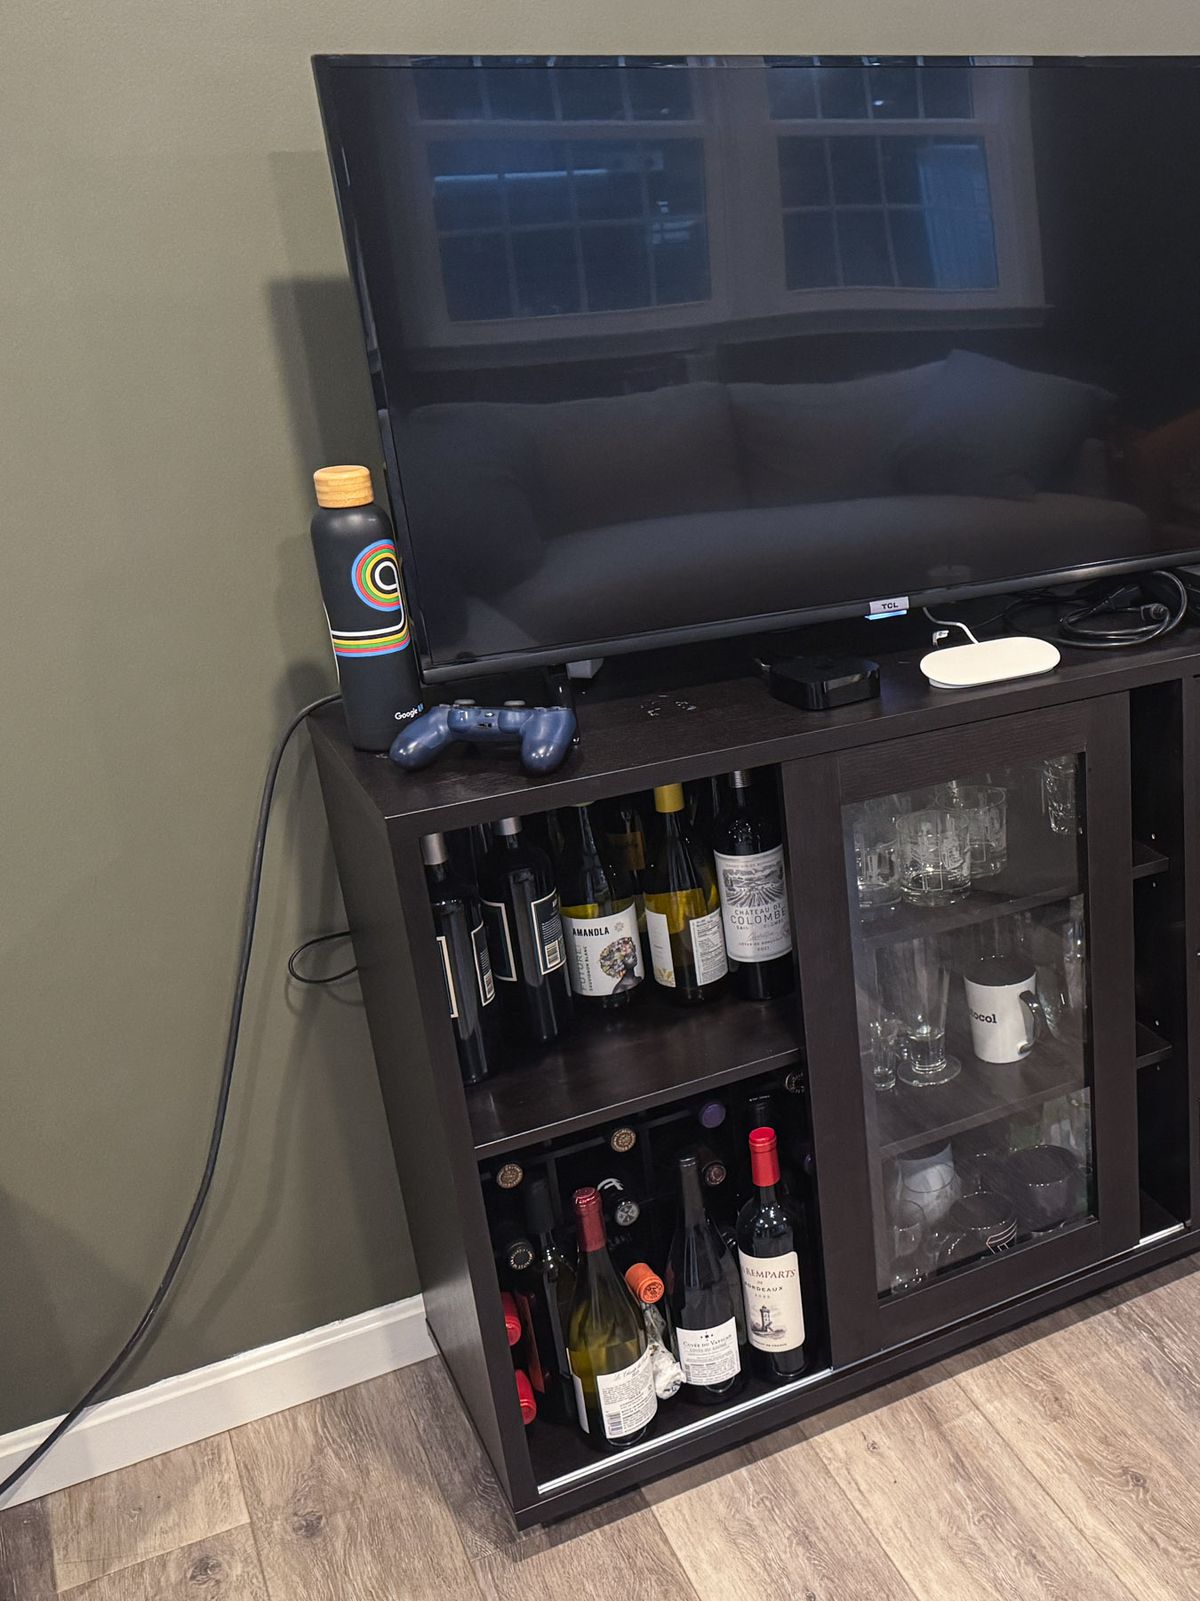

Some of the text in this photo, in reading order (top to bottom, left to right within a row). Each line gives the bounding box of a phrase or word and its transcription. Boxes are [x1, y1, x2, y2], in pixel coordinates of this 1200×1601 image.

[881, 601, 900, 610] TCL
[394, 707, 418, 720] Google
[730, 907, 787, 925] COLOMBE
[745, 1267, 796, 1279] REMPARTS
